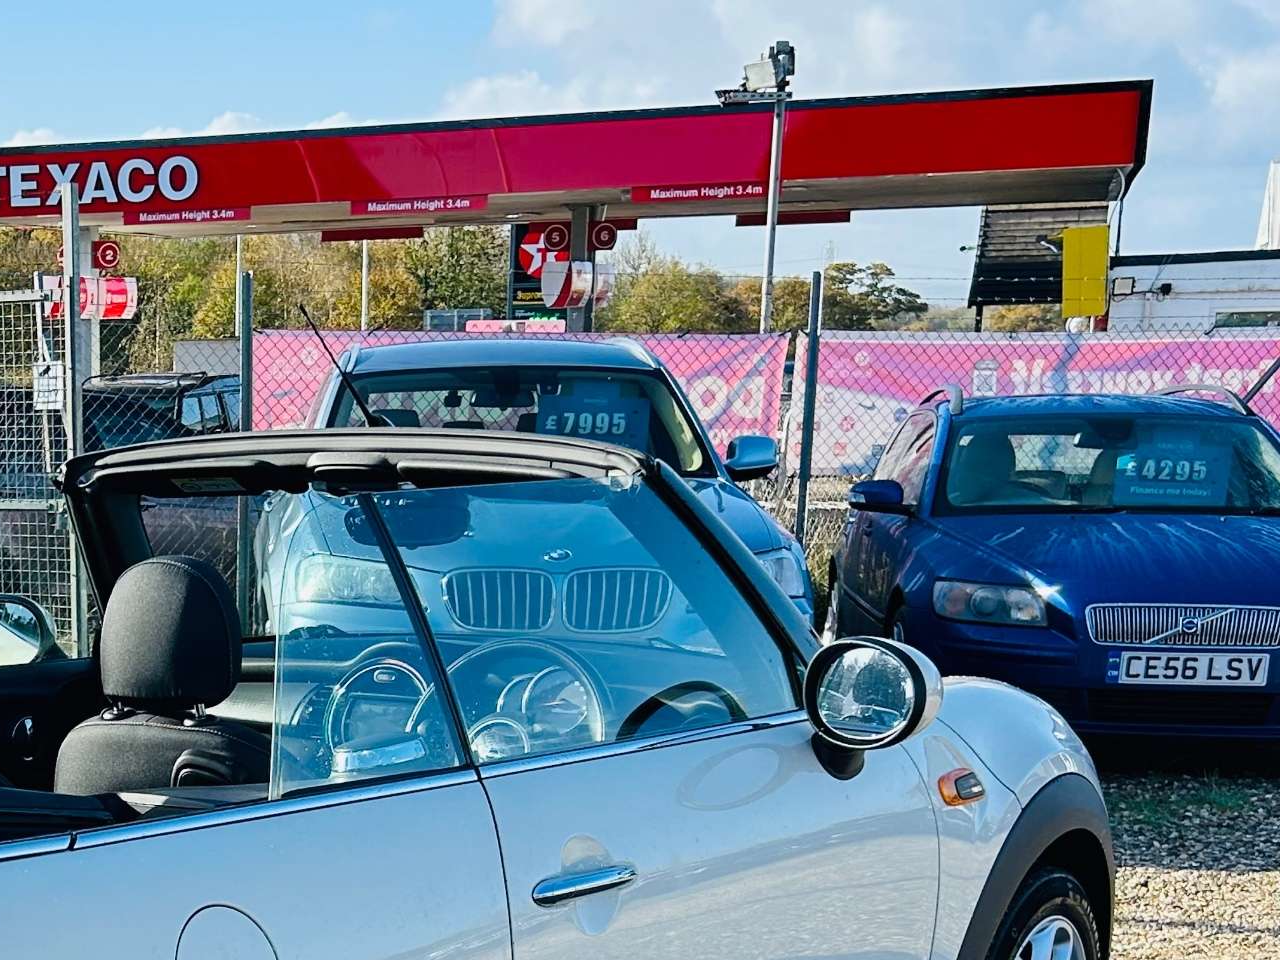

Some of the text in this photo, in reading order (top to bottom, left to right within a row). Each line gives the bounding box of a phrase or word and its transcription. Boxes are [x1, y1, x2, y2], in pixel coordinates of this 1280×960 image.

[650, 184, 763, 199] Maximum Height 3.4m
[367, 198, 470, 212] Maximum Height 3.4m
[139, 209, 235, 222] Maximum Height 3.4m
[551, 231, 561, 243] 5
[600, 230, 610, 242] 6
[104, 249, 115, 261] 2
[1130, 486, 1164, 496] Finance
[1166, 488, 1180, 496] me
[1124, 655, 1264, 681] CE56 LSV
